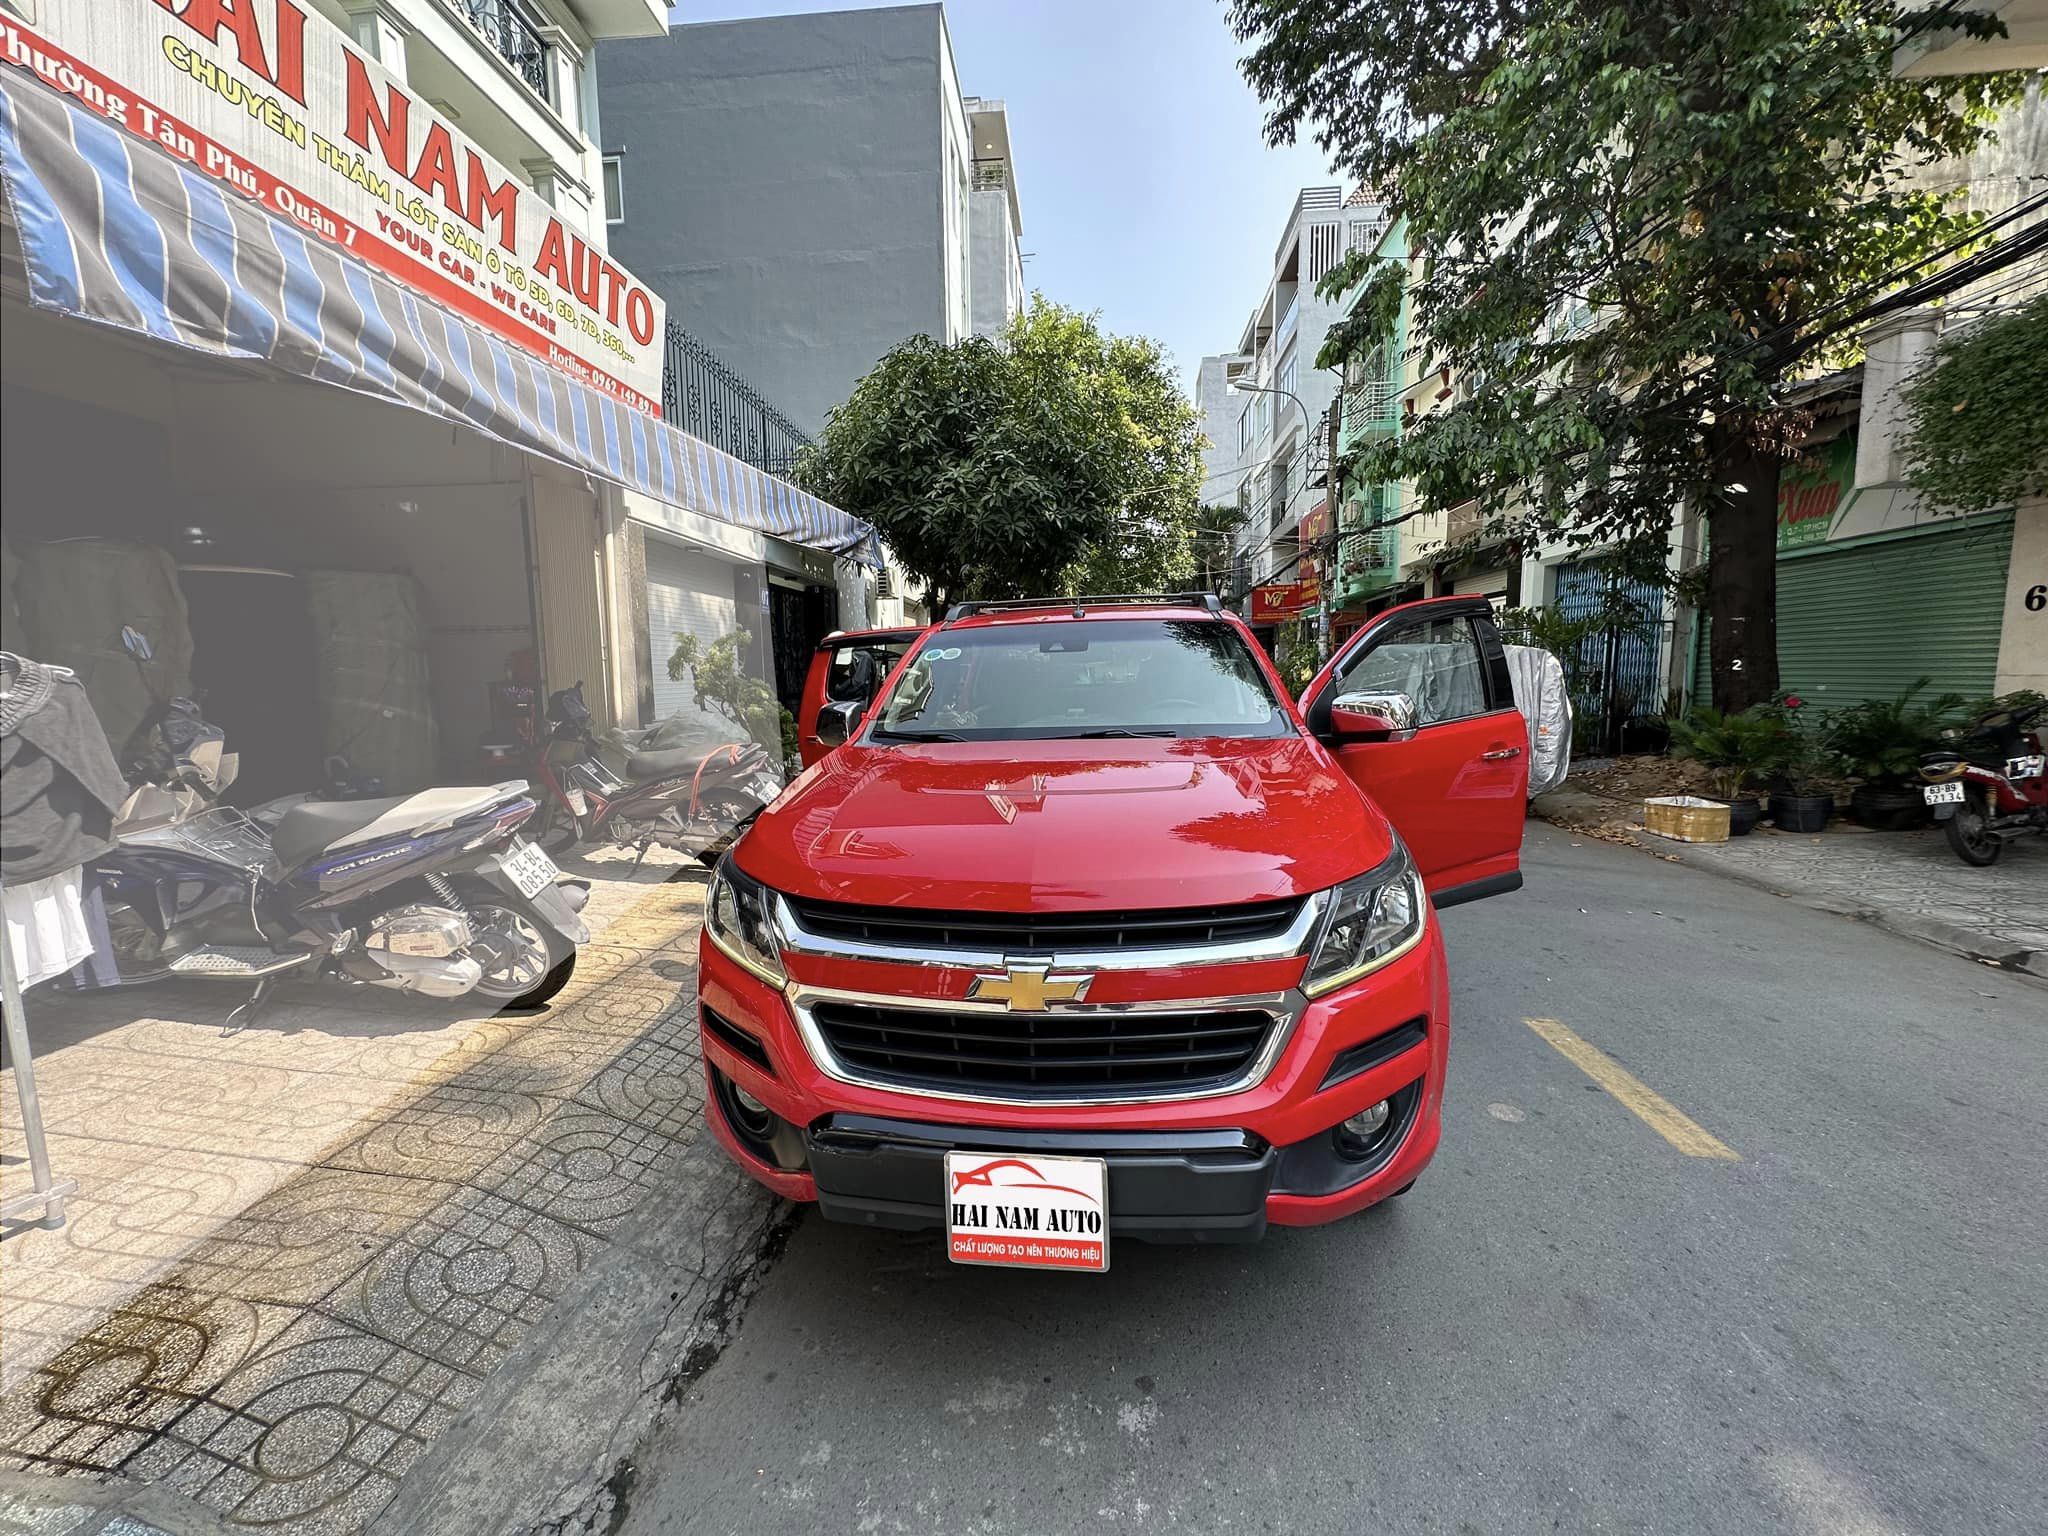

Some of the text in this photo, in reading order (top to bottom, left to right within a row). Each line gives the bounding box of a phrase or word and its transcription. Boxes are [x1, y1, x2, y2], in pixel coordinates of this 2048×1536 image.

[136, 102, 196, 160] Tân
[206, 143, 266, 200] Phú,
[345, 225, 357, 247] 7
[162, 35, 305, 149] CHUYÊN
[312, 132, 390, 204] THẢM
[396, 189, 438, 234] LÓT
[442, 222, 482, 264] SÀN
[486, 248, 500, 273] Ô
[504, 261, 526, 291] TÔ
[529, 280, 553, 312] 5D,
[556, 299, 578, 328] 6D,
[581, 314, 602, 344] 7D,
[342, 44, 520, 256] NAM
[533, 216, 654, 346] AUTO
[375, 209, 433, 261] YOUR
[438, 251, 476, 286] CAR
[490, 281, 515, 311] WE
[520, 301, 556, 335] CARE
[549, 343, 590, 379] Hotline:
[592, 369, 617, 394] 0962
[2025, 585, 2048, 612] 6
[1732, 659, 1742, 671] 2
[951, 1203, 1102, 1235] HAI NAM AUTO
[953, 1237, 1101, 1264] CHẤT LƯỢNG TẠO NÊN THƯƠNG HIỆU
